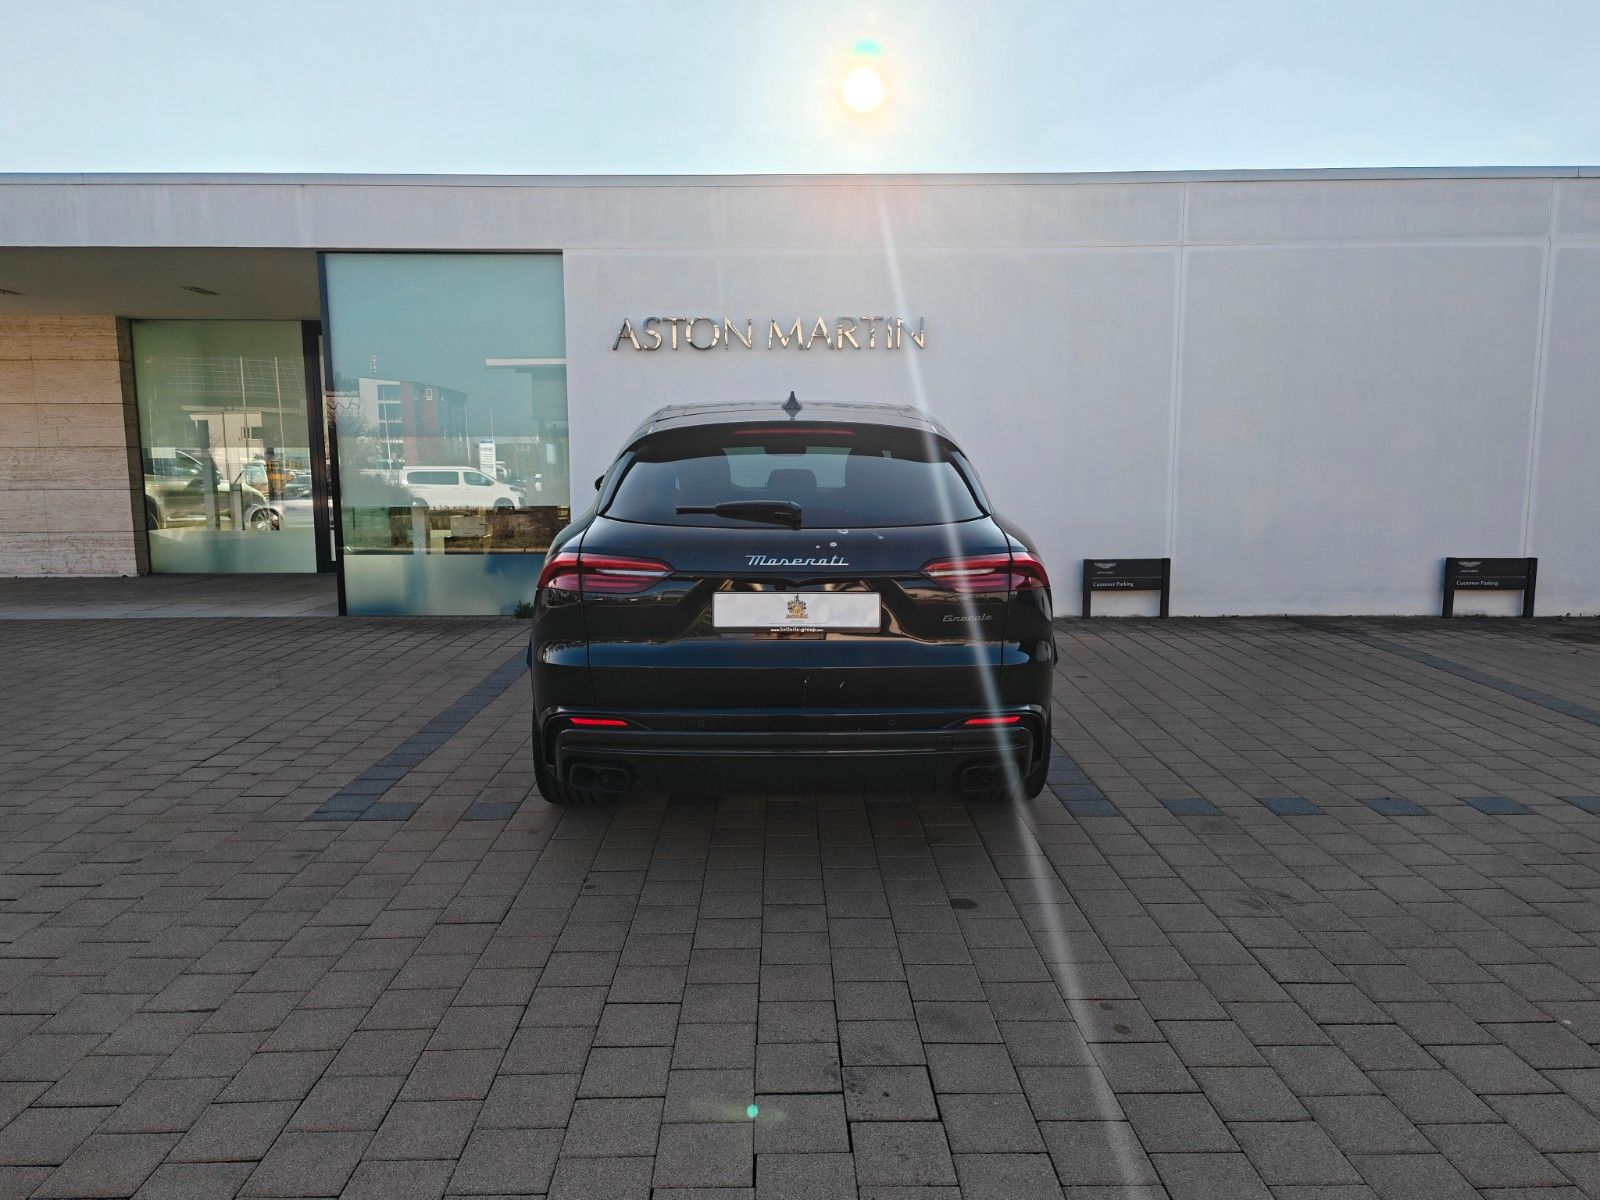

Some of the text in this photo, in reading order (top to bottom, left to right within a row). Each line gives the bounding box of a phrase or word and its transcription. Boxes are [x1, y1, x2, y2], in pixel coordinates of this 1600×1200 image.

[612, 316, 927, 351] ASTON MARTIN
[745, 554, 849, 566] Maserati
